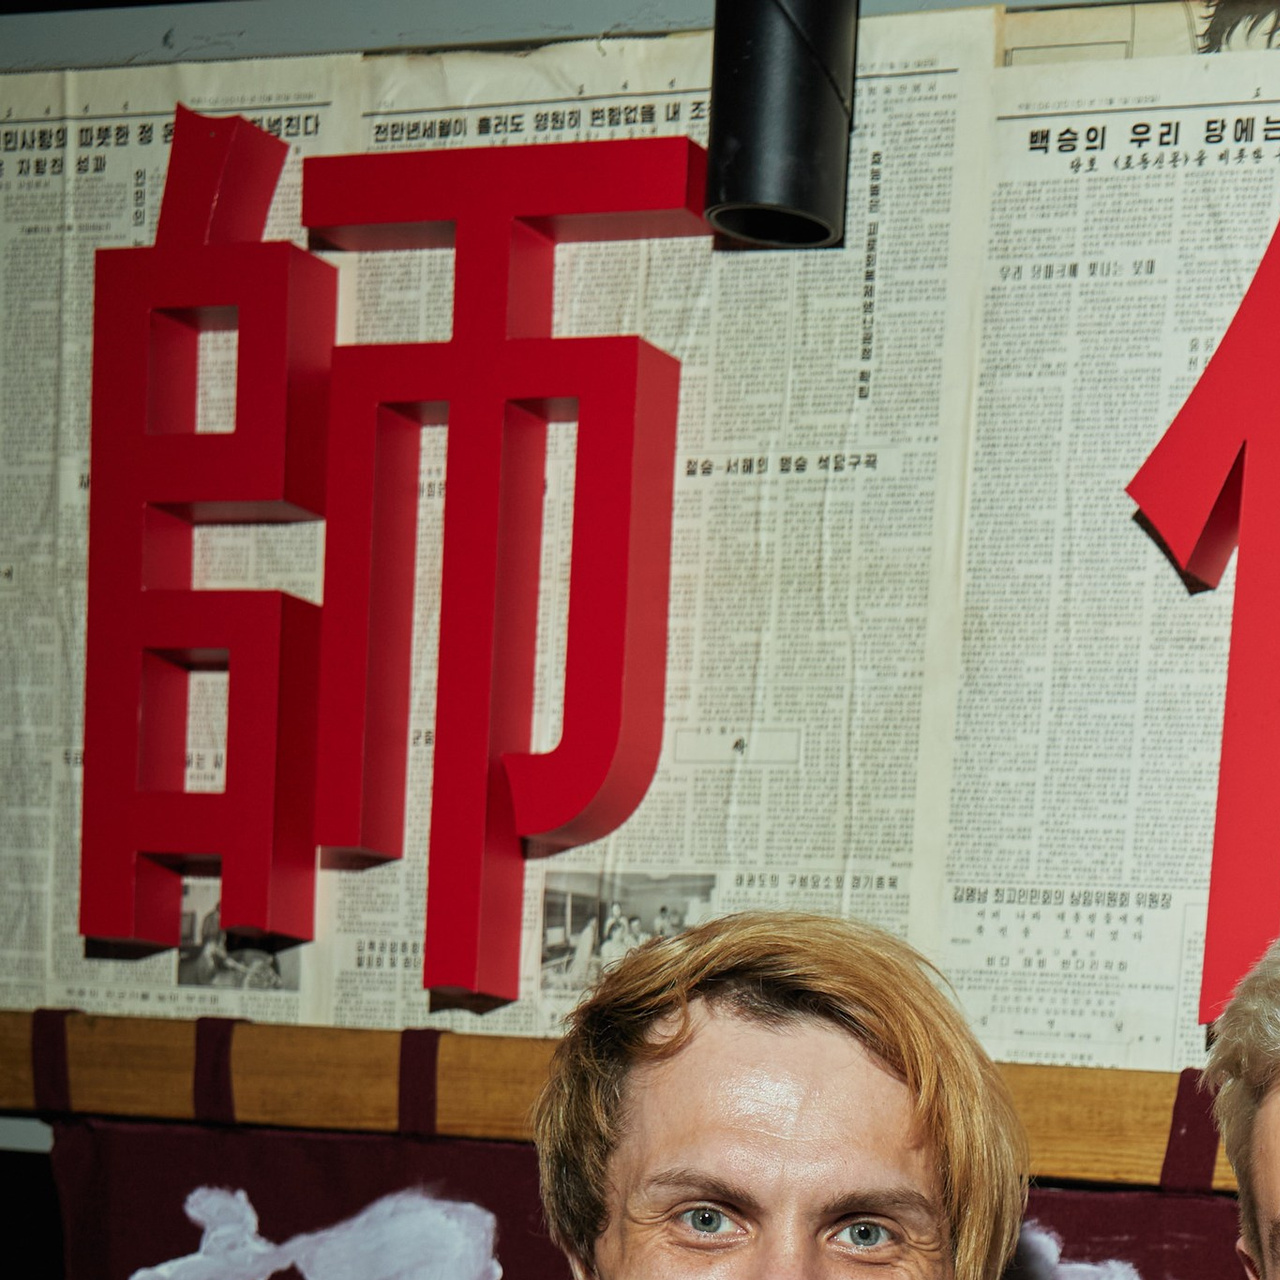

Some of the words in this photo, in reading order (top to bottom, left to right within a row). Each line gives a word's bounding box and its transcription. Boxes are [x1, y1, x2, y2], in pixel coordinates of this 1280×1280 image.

[0, 127, 67, 151] 민사랑의
[78, 123, 130, 148] 따뜻한
[250, 114, 321, 139] 넘친다
[478, 113, 525, 136] 흘러도
[534, 109, 581, 131] 영원히
[665, 102, 681, 122] 내
[1029, 125, 1107, 154] 백승의
[1130, 121, 1181, 148] 우리
[75, 154, 107, 174] 성과
[953, 885, 989, 904] 김영남
[992, 886, 1065, 906] 최고인민회의
[1069, 887, 1131, 908] 상임위원회
[1135, 890, 1173, 910] 위원장
